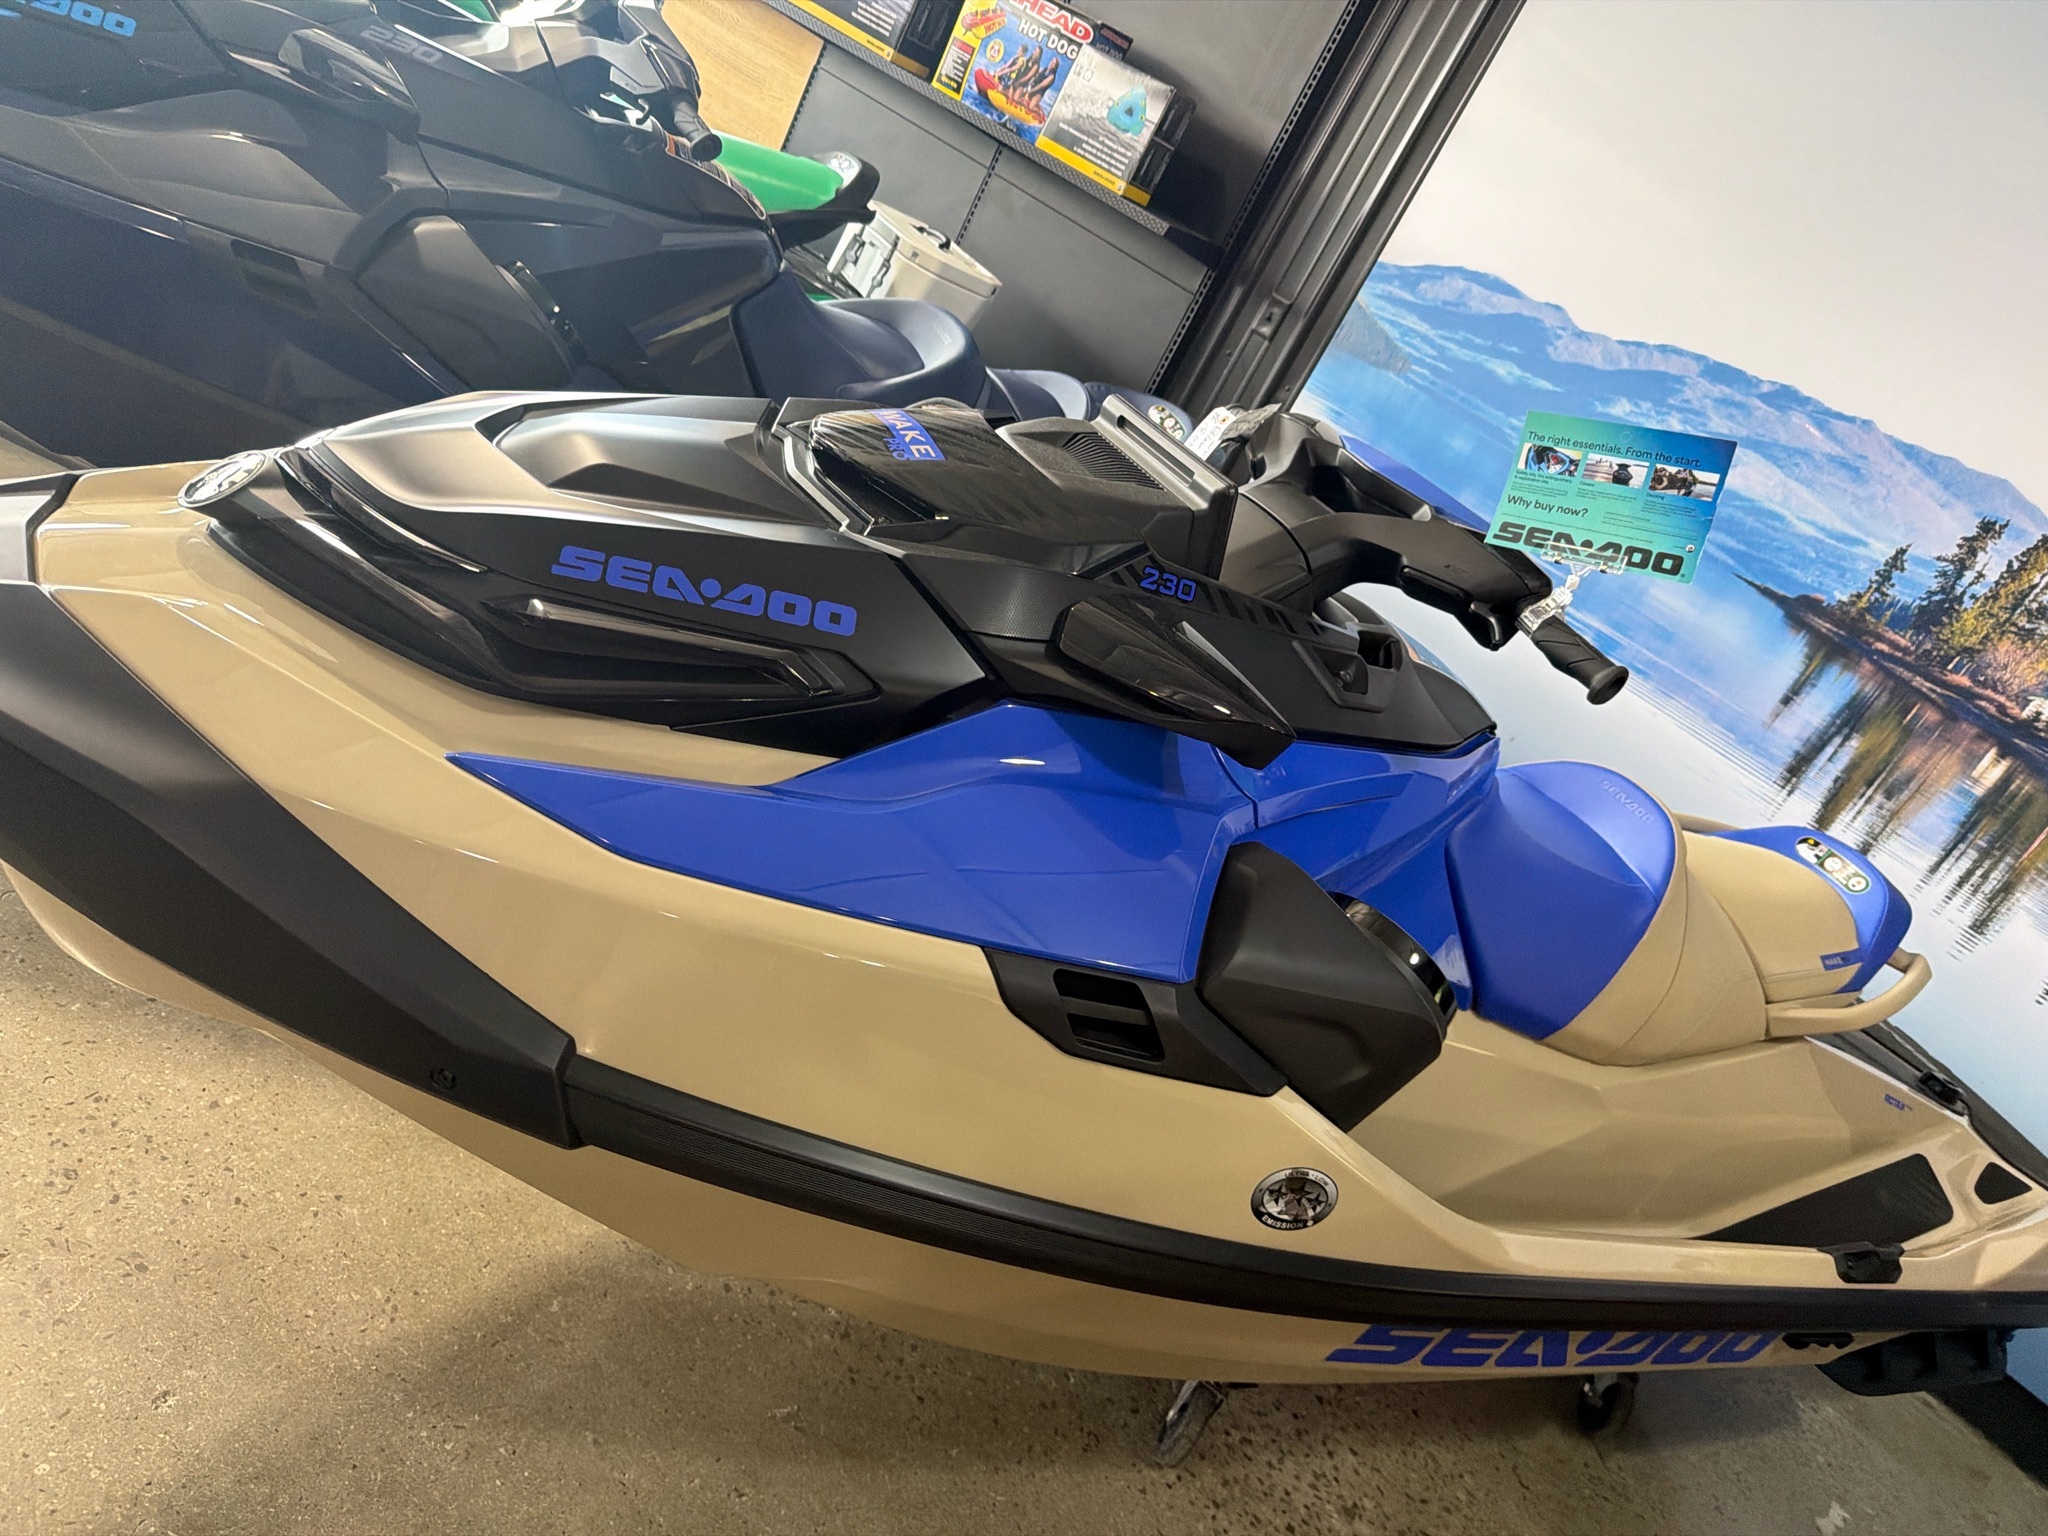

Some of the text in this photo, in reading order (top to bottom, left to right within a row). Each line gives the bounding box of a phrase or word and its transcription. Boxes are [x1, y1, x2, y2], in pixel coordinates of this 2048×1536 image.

[360, 25, 443, 63] 230
[1018, 19, 1048, 43] HOT
[1046, 32, 1079, 60] DOG
[879, 411, 936, 458] WAKE
[883, 437, 909, 460] PRO
[1528, 431, 1701, 468] The right essentials. From the start.
[1507, 494, 1589, 518] Why buy now?
[1140, 566, 1197, 602] 230
[1261, 1214, 1304, 1229] EMISSION
